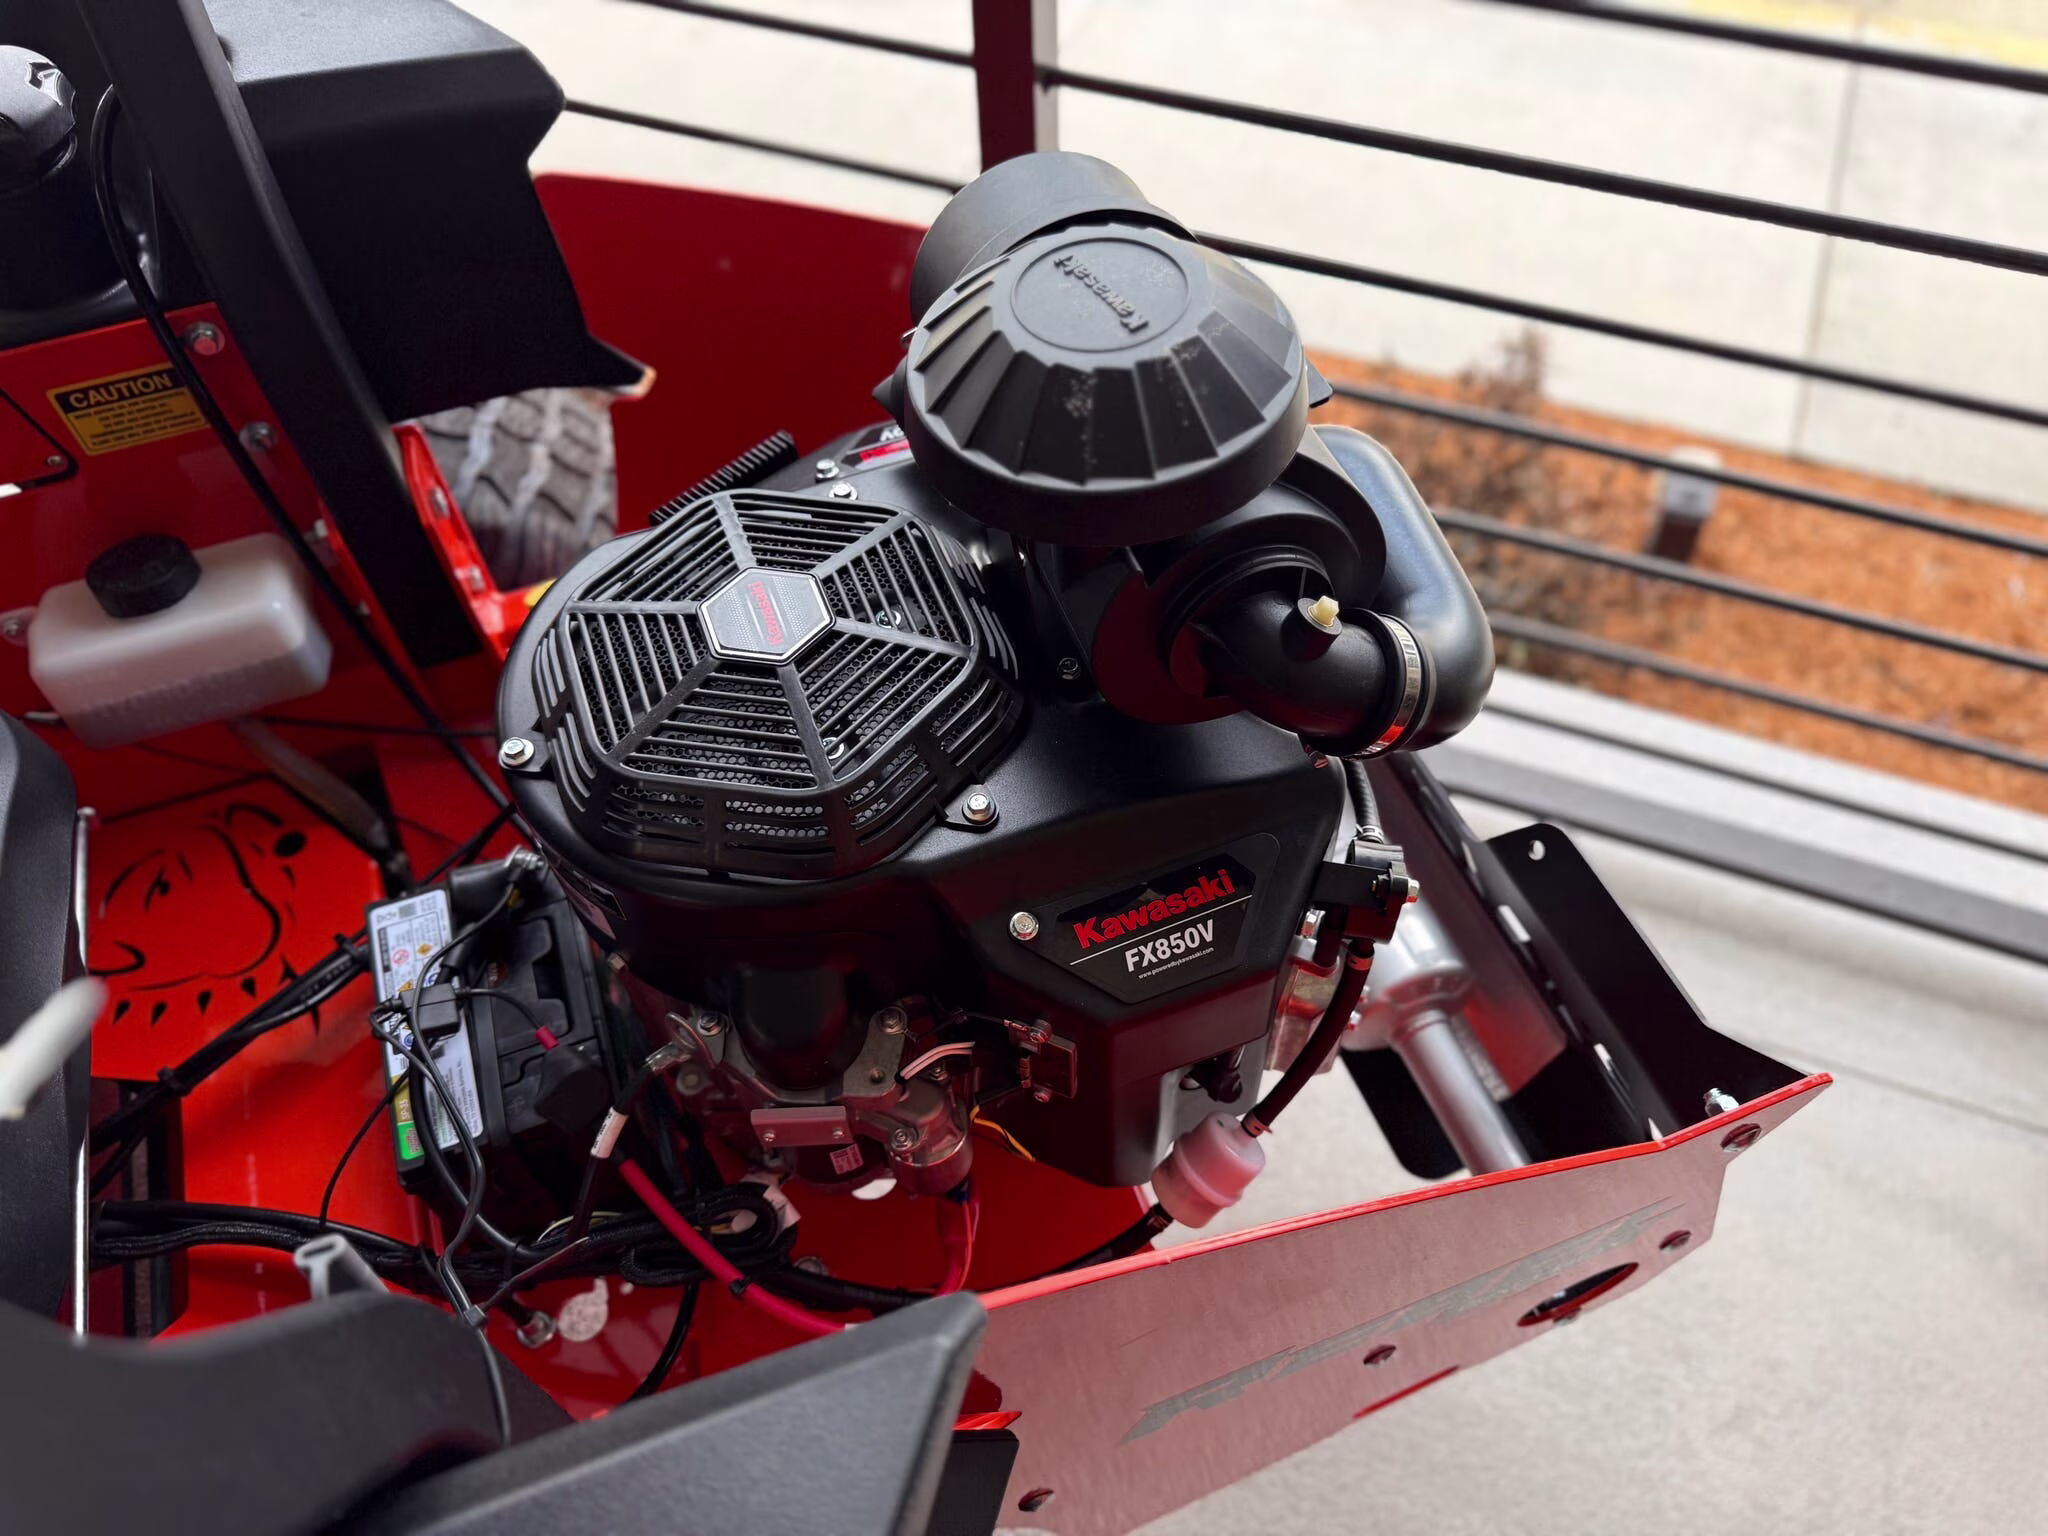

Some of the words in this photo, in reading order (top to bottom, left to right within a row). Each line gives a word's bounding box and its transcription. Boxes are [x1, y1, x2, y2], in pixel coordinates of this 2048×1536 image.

[1053, 255, 1149, 333] Kawasaki
[69, 373, 173, 409] CAUTION
[747, 579, 785, 647] Kawasaki
[1073, 868, 1236, 949] Kawasaki
[1124, 919, 1214, 973] FX850V
[1137, 947, 1215, 980] www.poweredbykawasaki.com
